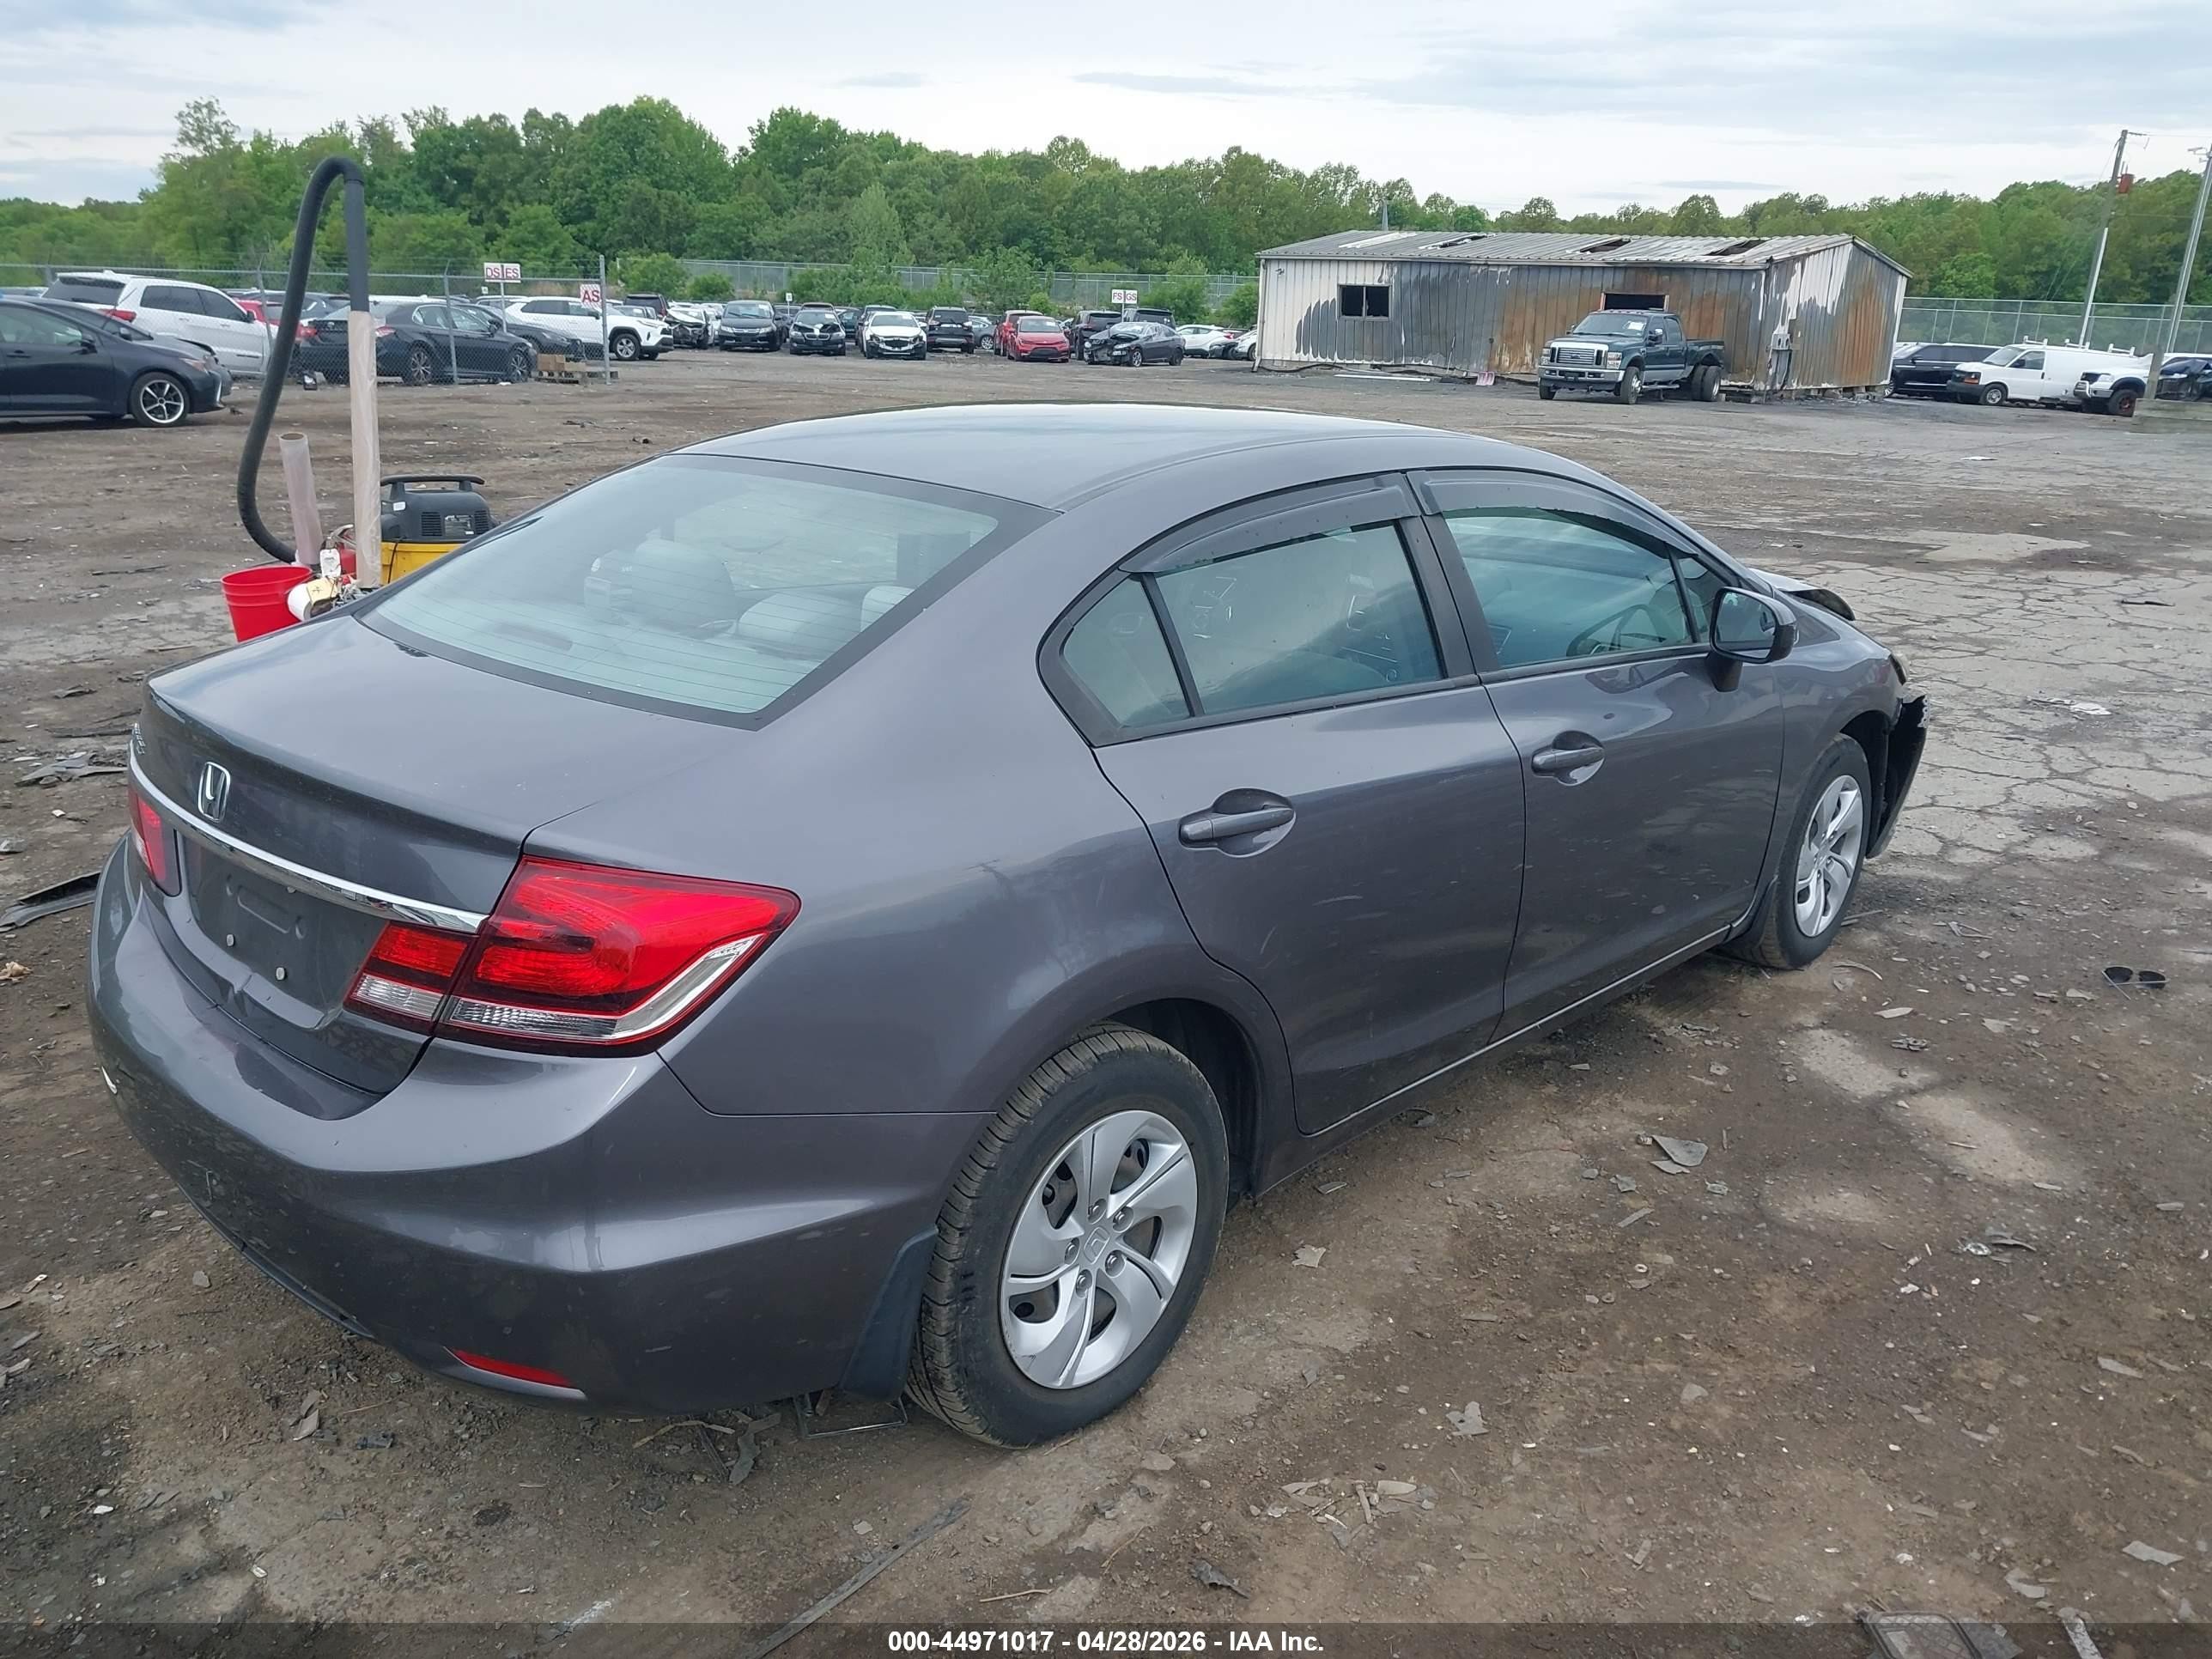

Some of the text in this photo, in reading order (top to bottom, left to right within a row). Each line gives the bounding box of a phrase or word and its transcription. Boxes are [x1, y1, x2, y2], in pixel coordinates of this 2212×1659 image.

[485, 267, 501, 279] DS
[505, 268, 520, 279] ES
[582, 289, 600, 303] AS
[1113, 292, 1123, 301] FS
